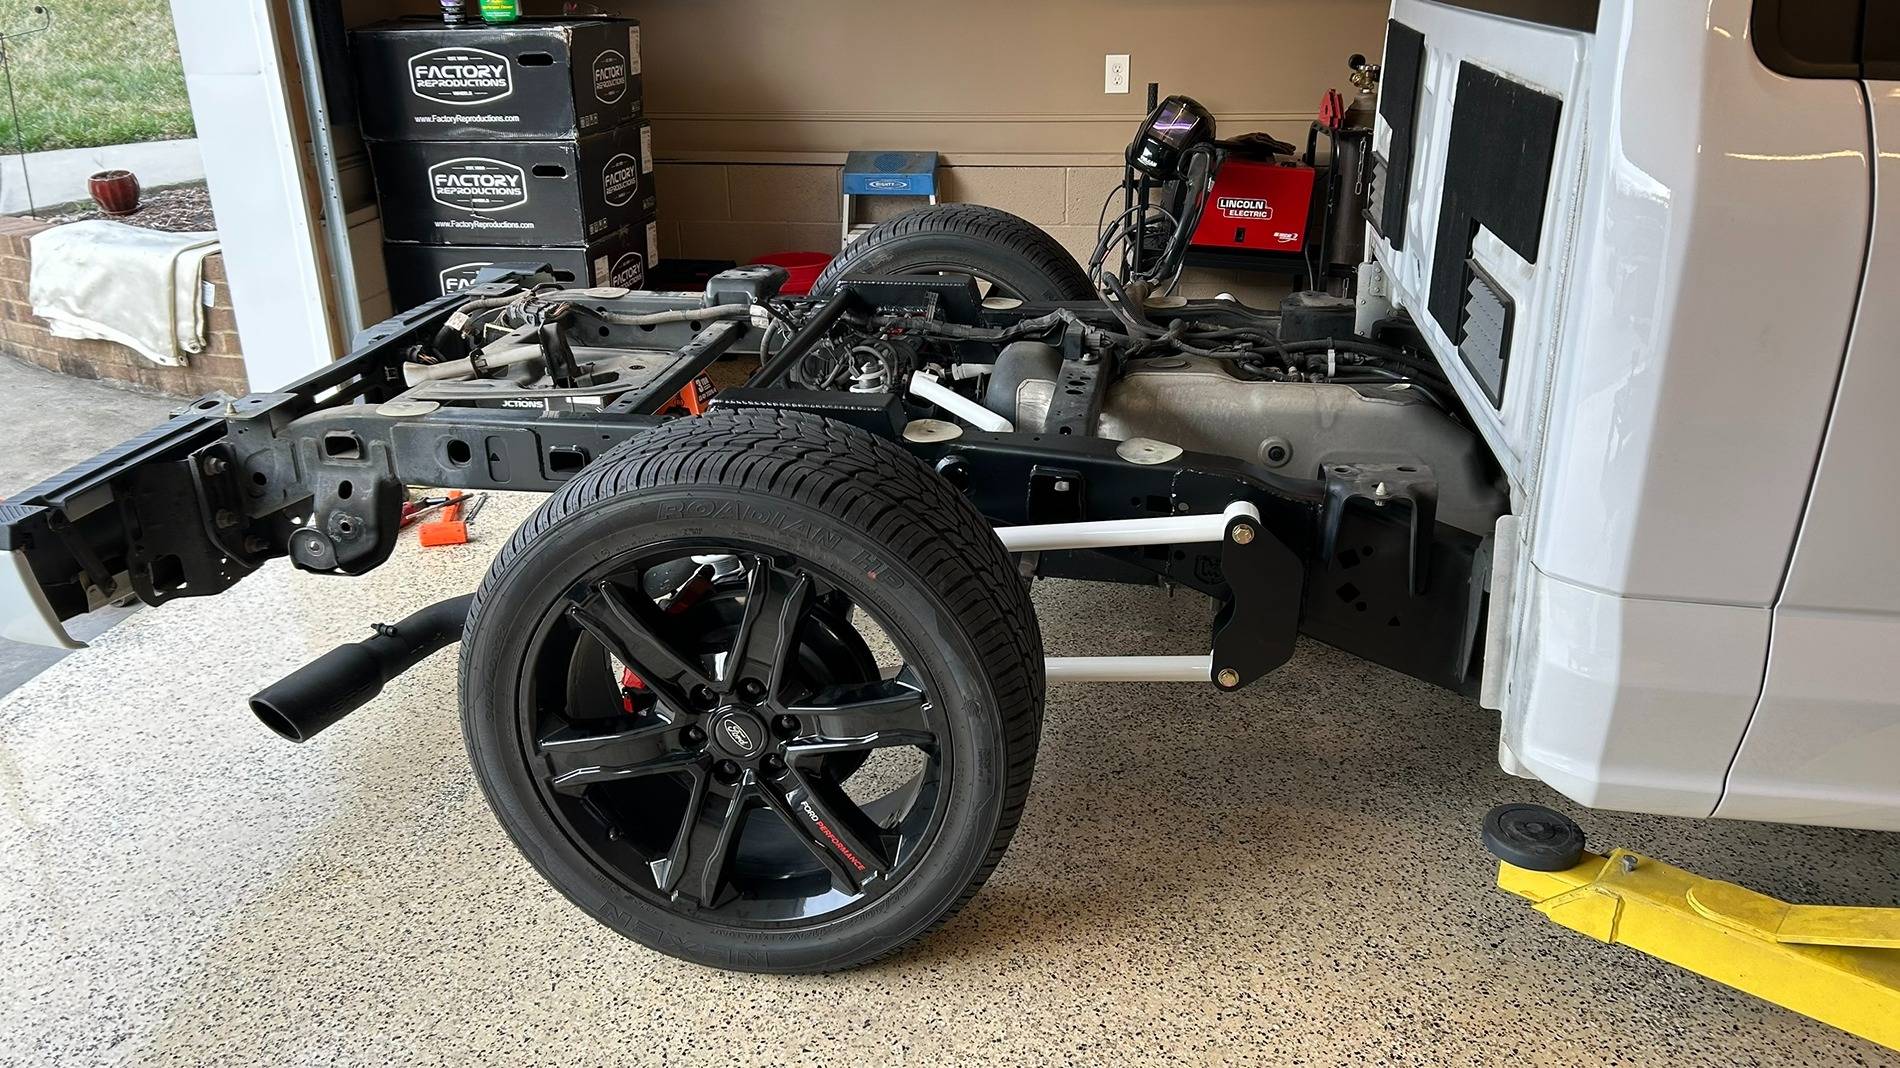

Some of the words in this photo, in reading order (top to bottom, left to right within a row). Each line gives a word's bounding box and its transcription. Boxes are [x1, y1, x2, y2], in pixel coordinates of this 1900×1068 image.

[415, 64, 504, 79] FACTORY
[595, 64, 624, 81] FACTORY
[416, 78, 507, 88] REPRODUCTIONS
[414, 114, 520, 124] www.FactoryReproductions.com
[435, 174, 519, 187] FACTORY
[605, 165, 635, 187] FACTORY
[436, 187, 522, 196] REPRODUCTIONS
[1220, 199, 1264, 209] LINCOLN
[1229, 209, 1267, 218] ELECTRIC
[434, 220, 535, 230] www.FactoryReproductions.com
[656, 500, 843, 550] ROADIAN
[851, 549, 905, 591] HP
[727, 725, 749, 746] Ford
[800, 800, 819, 822] FORD
[816, 820, 866, 871] PERFORMANCE
